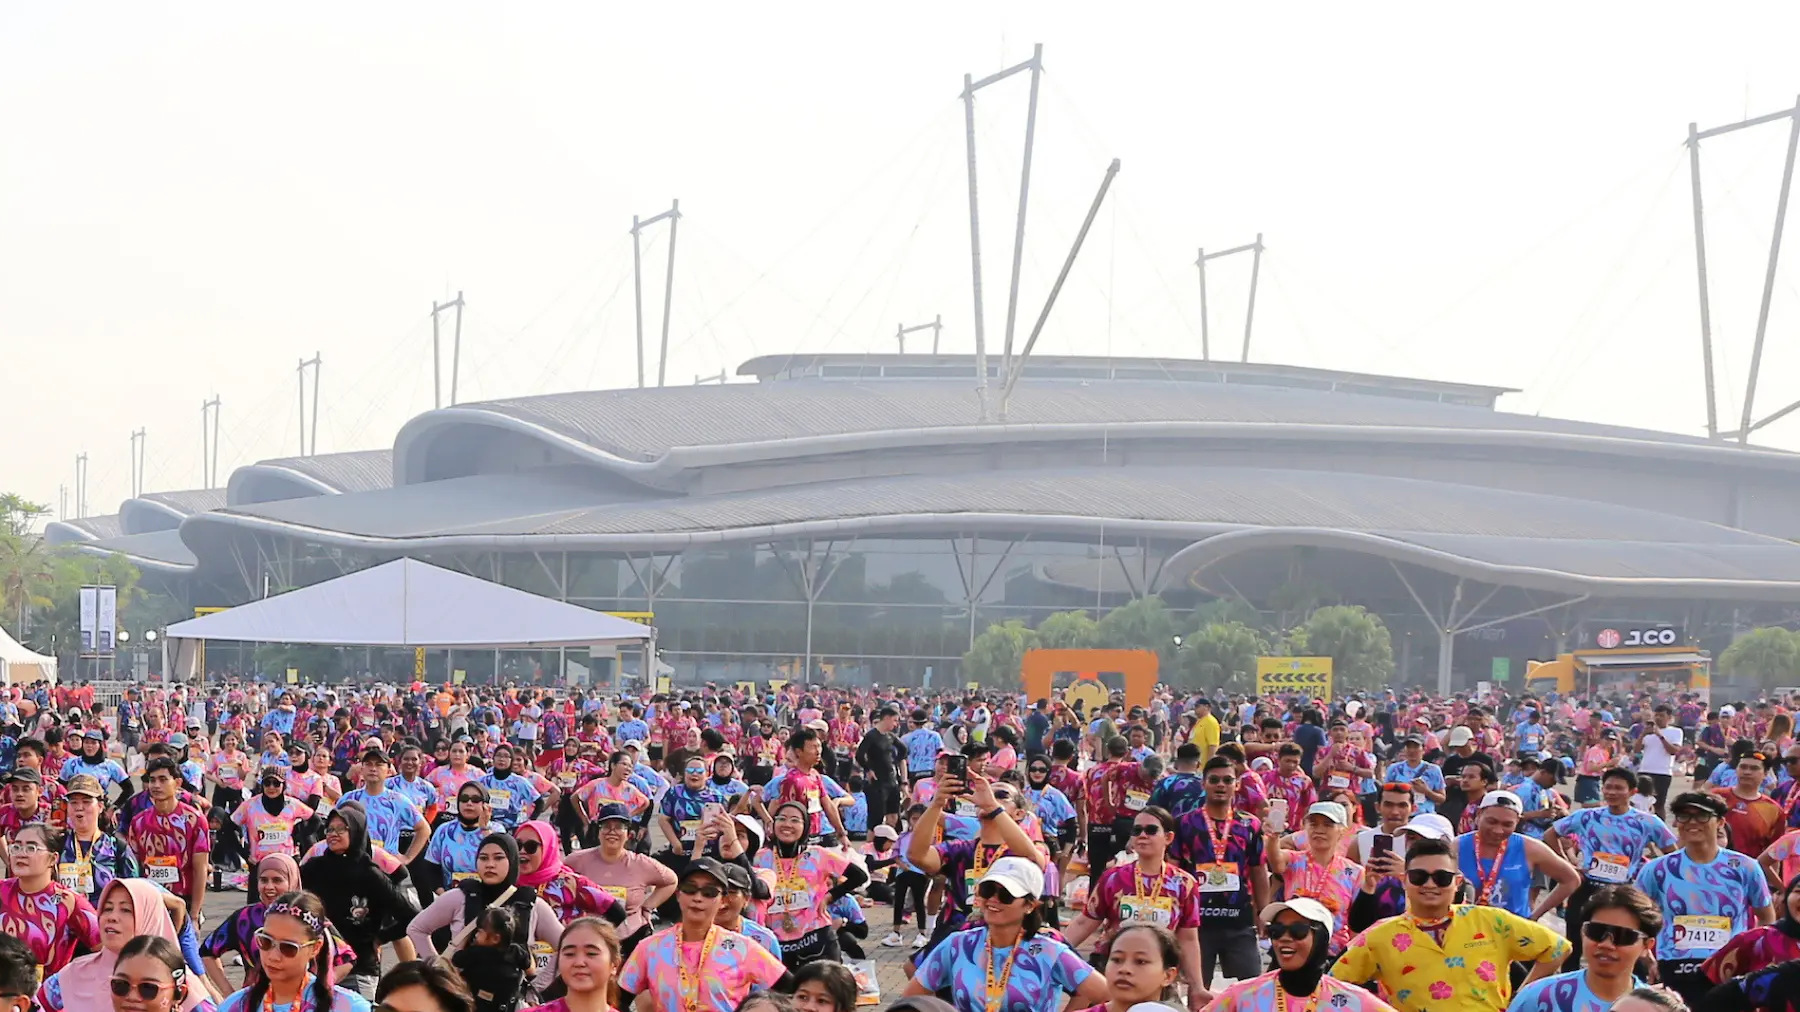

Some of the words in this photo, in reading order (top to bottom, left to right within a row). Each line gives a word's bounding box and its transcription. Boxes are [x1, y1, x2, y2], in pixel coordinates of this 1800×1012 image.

[1624, 630, 1677, 647] J.CO
[151, 868, 169, 878] 3896
[1687, 930, 1715, 942] 7412
